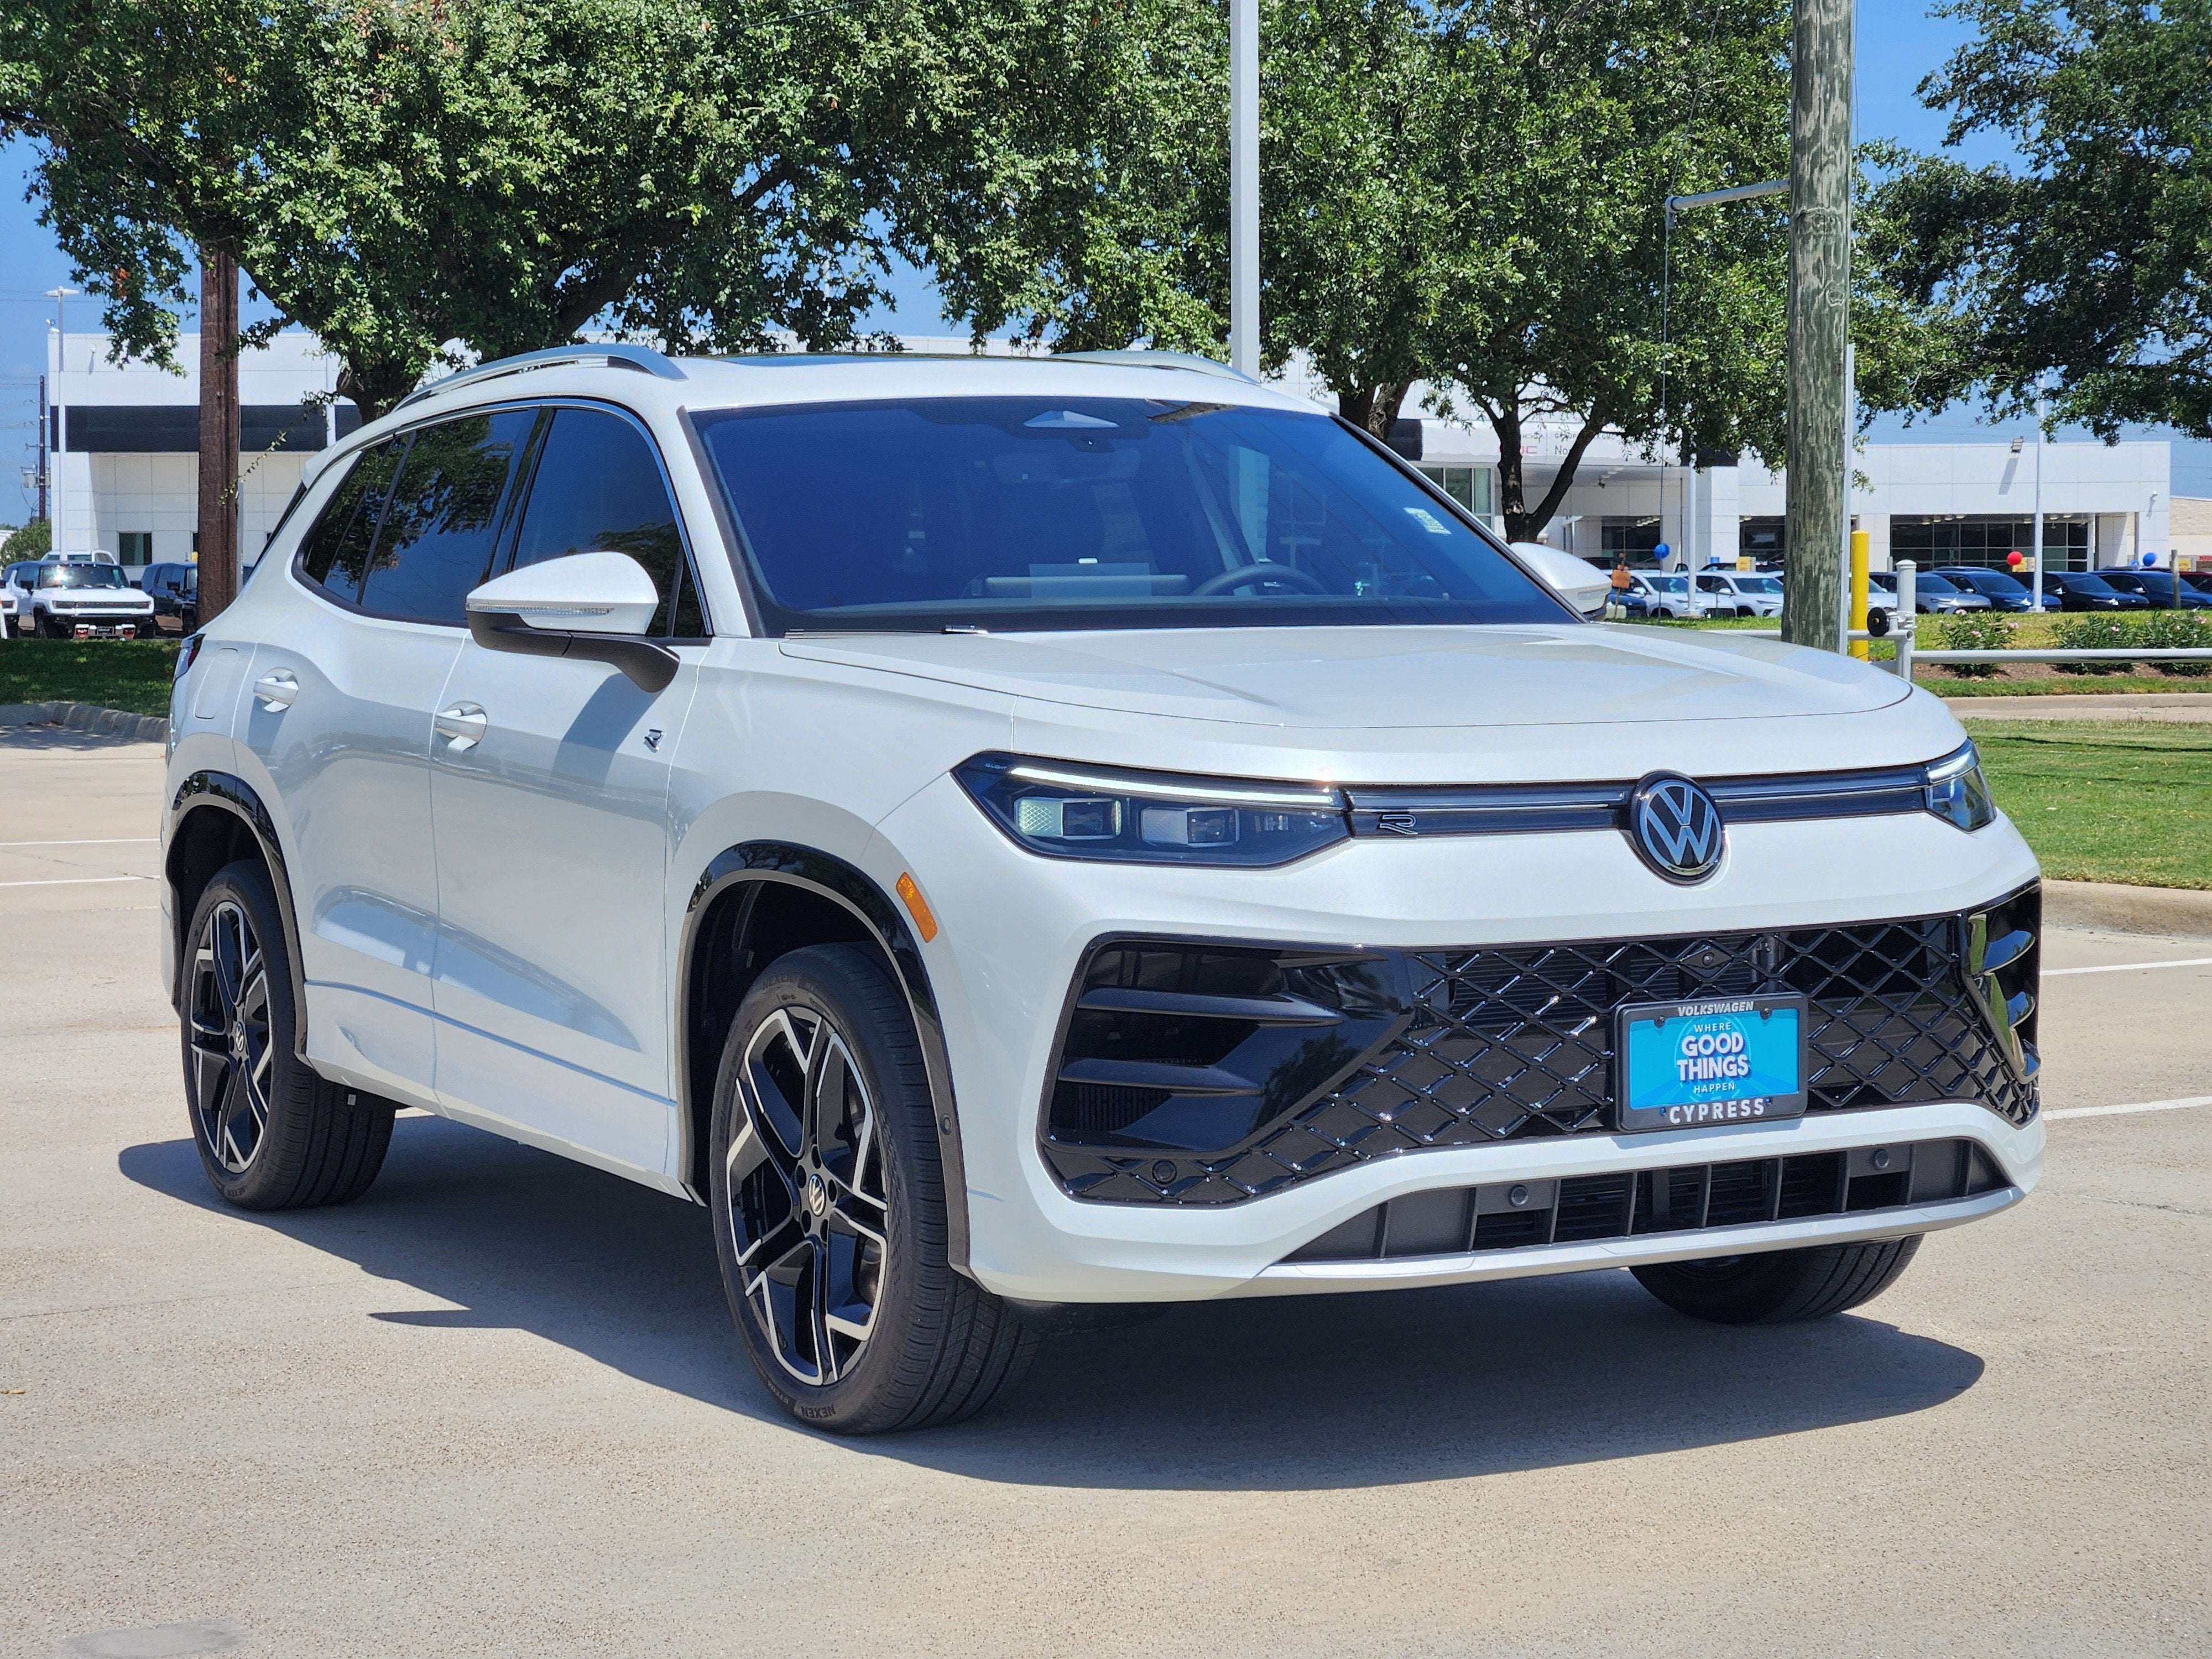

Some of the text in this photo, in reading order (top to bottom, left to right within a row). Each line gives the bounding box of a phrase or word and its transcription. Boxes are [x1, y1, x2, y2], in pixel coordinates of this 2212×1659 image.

[1379, 814, 1419, 835] R
[1641, 780, 1721, 874] VW
[1678, 1001, 1754, 1017] VOLKSWAGEN
[1694, 1022, 1732, 1032] WHERE
[1681, 1031, 1745, 1057] GOOD
[1677, 1055, 1750, 1082] THINGS
[1694, 1082, 1735, 1094] HAPPEN
[1669, 1098, 1765, 1124] CYPRESS
[801, 1403, 836, 1418] NEXEN
